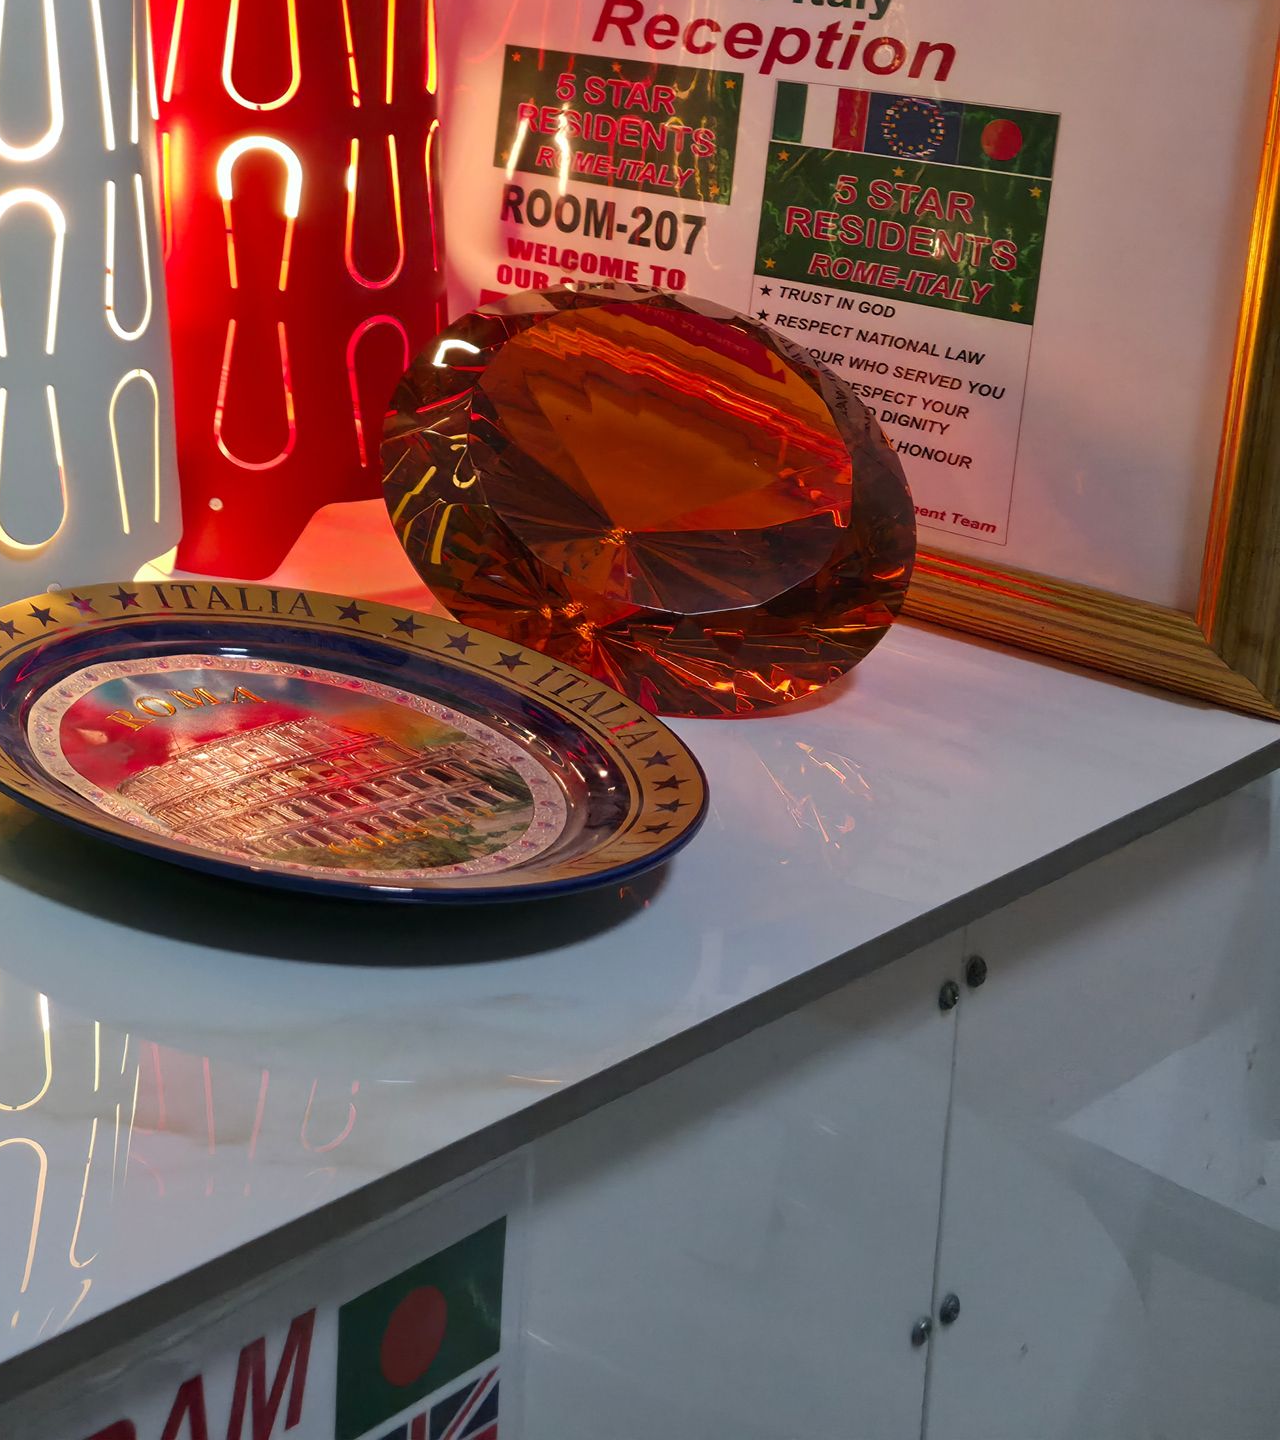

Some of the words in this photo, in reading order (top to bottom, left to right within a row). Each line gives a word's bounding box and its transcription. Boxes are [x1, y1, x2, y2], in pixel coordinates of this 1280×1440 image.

[556, 72, 577, 101] 5
[583, 76, 677, 116] STAR
[517, 102, 717, 158] RESIDENTS
[500, 183, 707, 256] ROOM-207
[833, 174, 858, 204] 5
[866, 179, 976, 224] STAR
[784, 206, 1019, 272] RESIDENTS
[496, 264, 550, 290] OUR
[507, 237, 640, 283] WELCOME
[649, 265, 687, 291] TO
[806, 252, 995, 306] ROME-ITALY
[779, 286, 835, 307] TRUST
[836, 297, 855, 311] IN
[858, 301, 896, 319] GOD
[774, 313, 854, 339] RESPECT
[855, 329, 941, 358] NATIONAL
[944, 346, 986, 366] LAW
[848, 355, 889, 376] WHO
[892, 365, 963, 392] SERVED
[967, 379, 1006, 400] YOU
[880, 409, 951, 436] DIGNITY
[921, 396, 970, 420] YOUR
[896, 440, 973, 470] HONOUR
[951, 512, 998, 535] Team
[151, 582, 317, 619] ITALIA
[106, 685, 269, 733] ROMA
[529, 664, 659, 750] ITALIA
